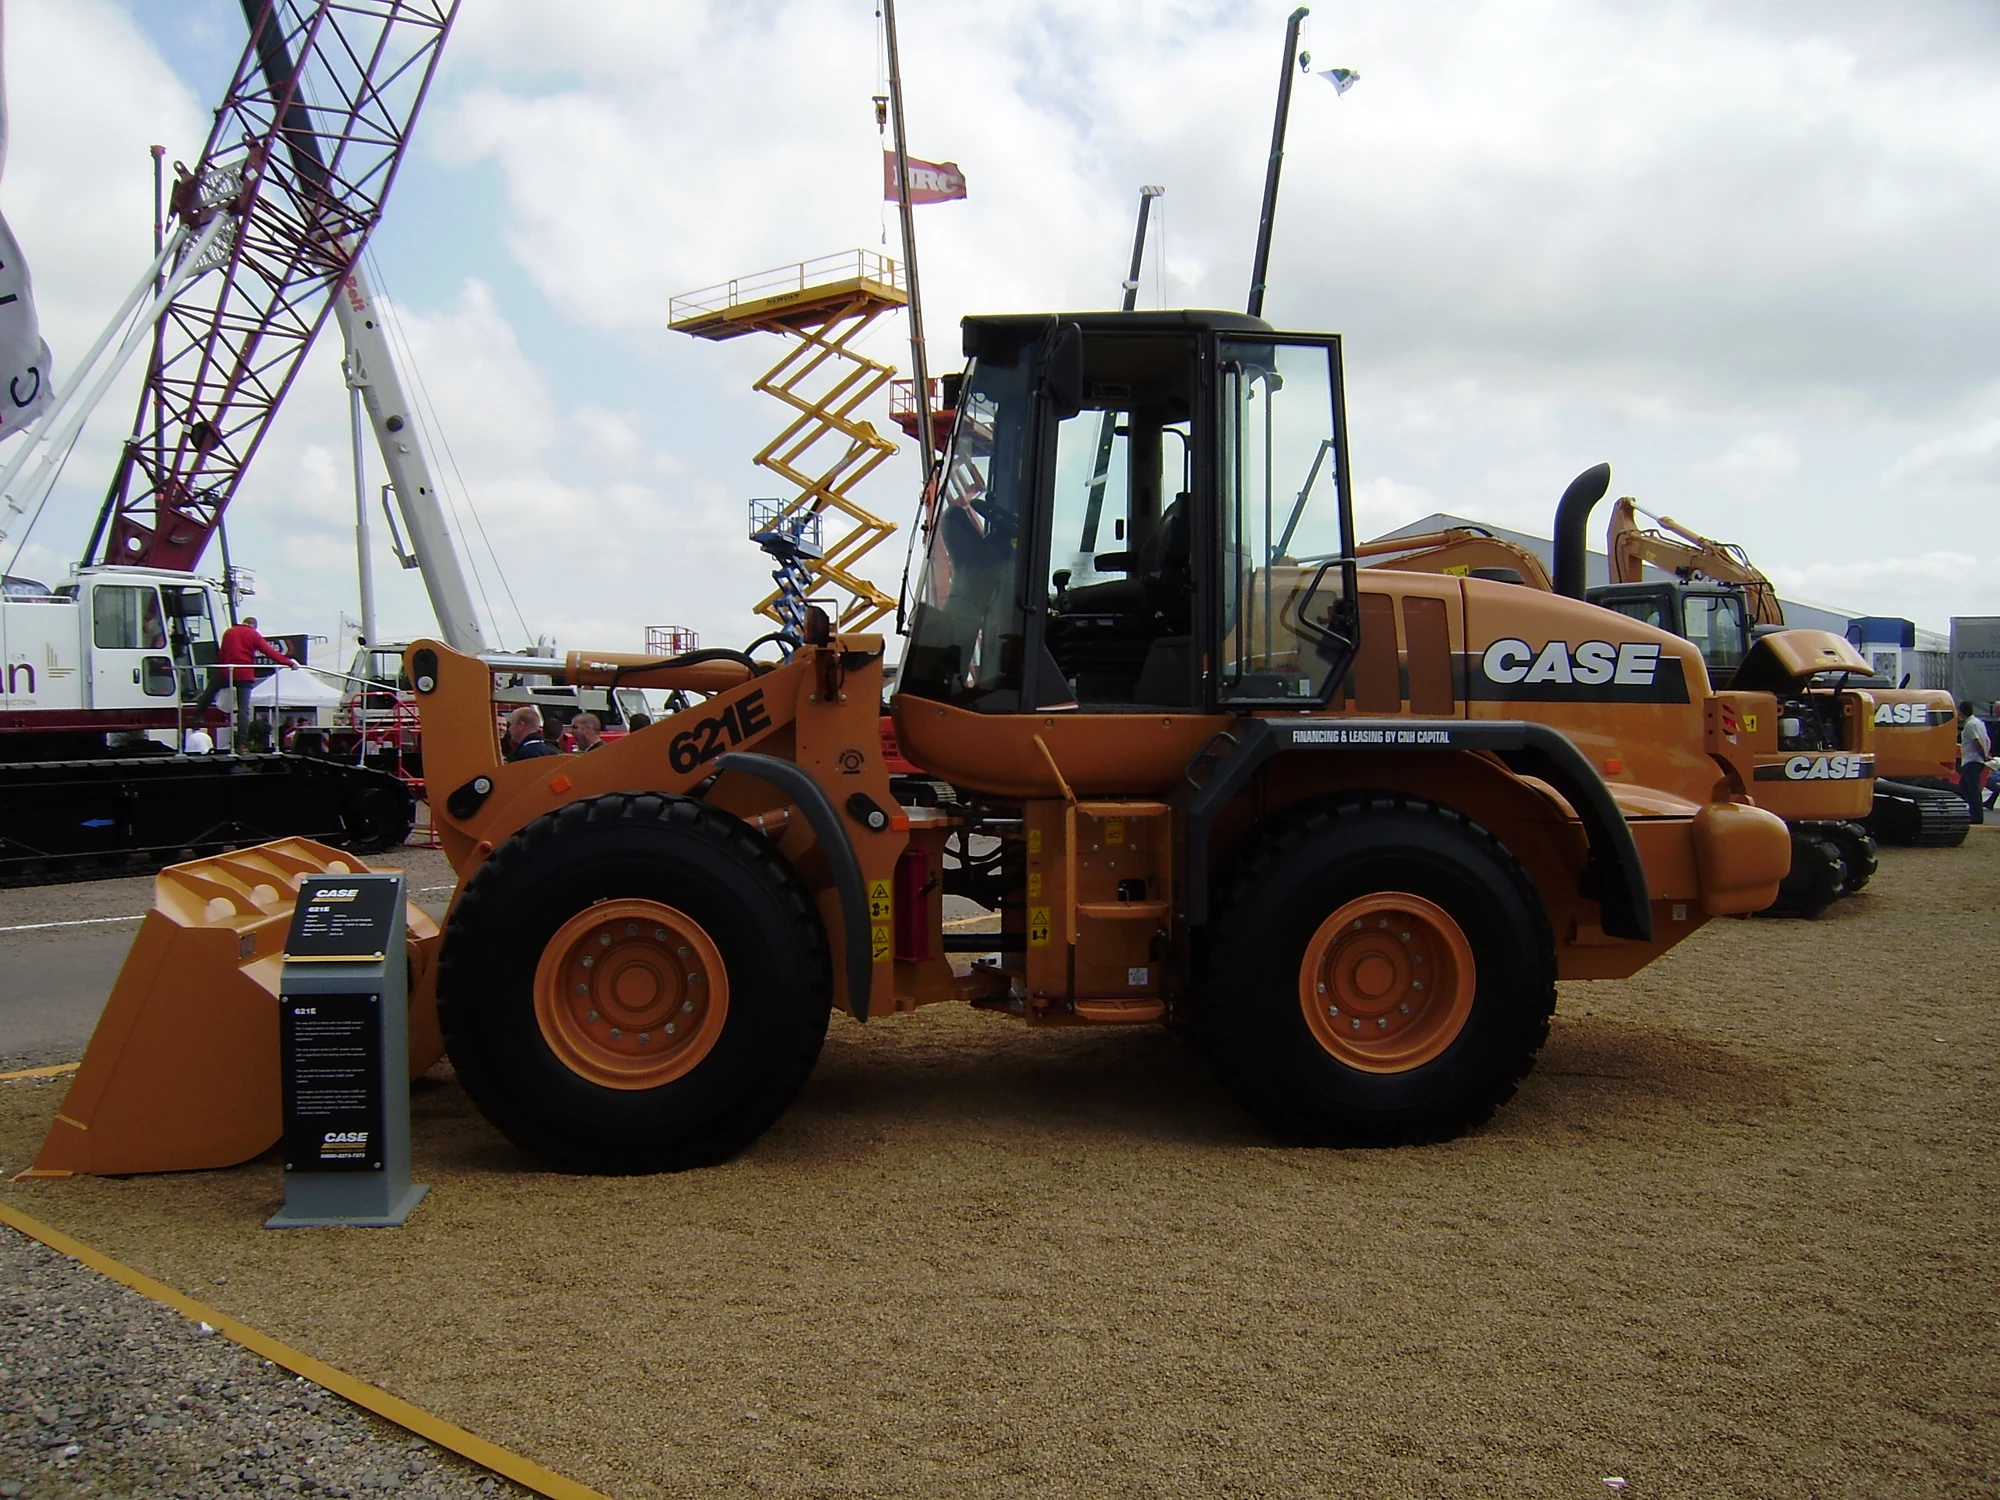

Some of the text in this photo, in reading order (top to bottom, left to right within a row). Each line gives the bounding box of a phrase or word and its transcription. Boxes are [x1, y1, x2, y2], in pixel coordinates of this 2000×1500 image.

[1483, 638, 1661, 685] CASE
[669, 688, 772, 774] 621E
[1292, 730, 1450, 743] FINANCING & LEASING BY CNH CAPITAL
[1785, 756, 1861, 779] CASE
[316, 889, 359, 897] CASE
[324, 1132, 369, 1142] CASE
